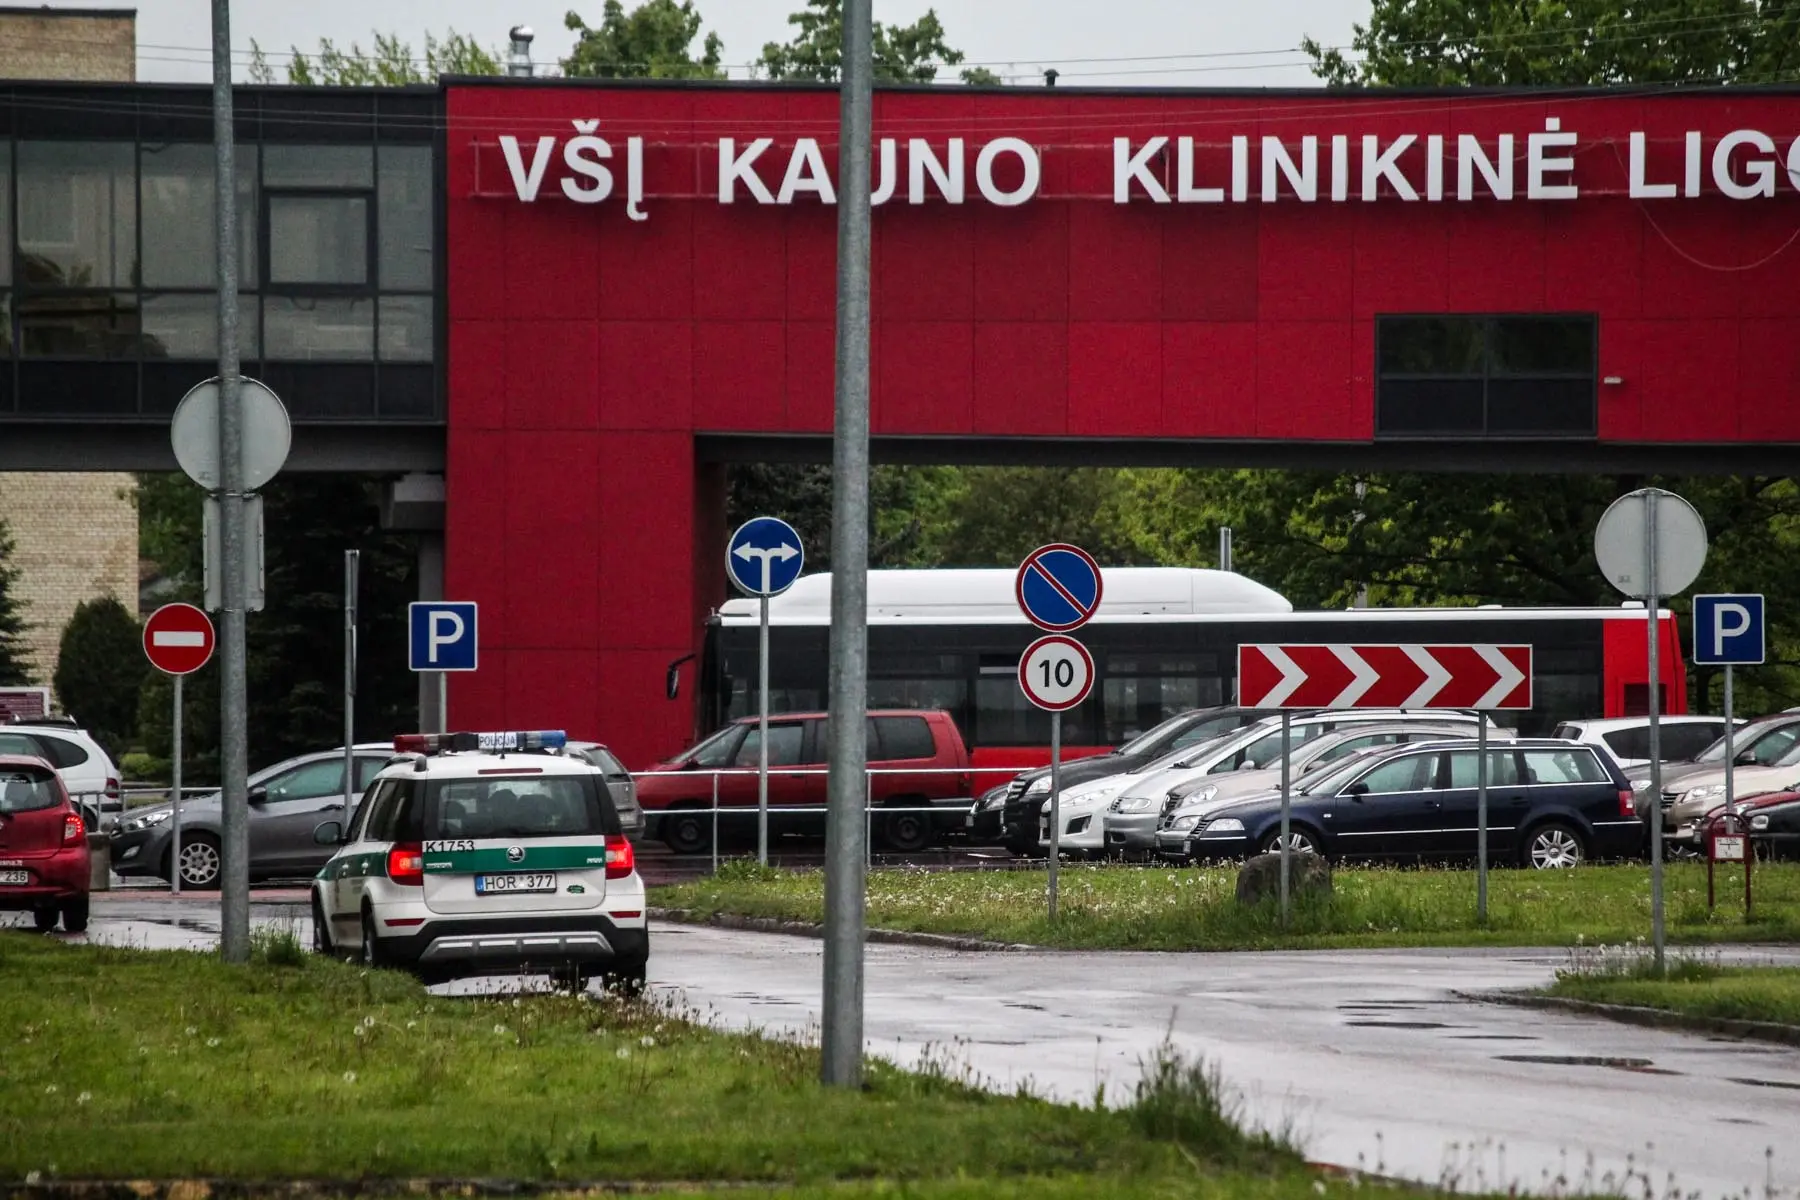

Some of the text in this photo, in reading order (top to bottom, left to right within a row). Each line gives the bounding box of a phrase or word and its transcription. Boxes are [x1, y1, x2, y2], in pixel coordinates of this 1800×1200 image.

[499, 119, 648, 221] VŠĮ
[1113, 116, 1579, 204] KLINIKINĖ
[1628, 128, 1800, 201] LIG
[428, 610, 465, 663] P
[1714, 603, 1751, 656] P
[1039, 658, 1074, 688] 10
[425, 840, 475, 854] K1753
[6, 871, 26, 882] 236
[484, 874, 553, 890] HOR 377
